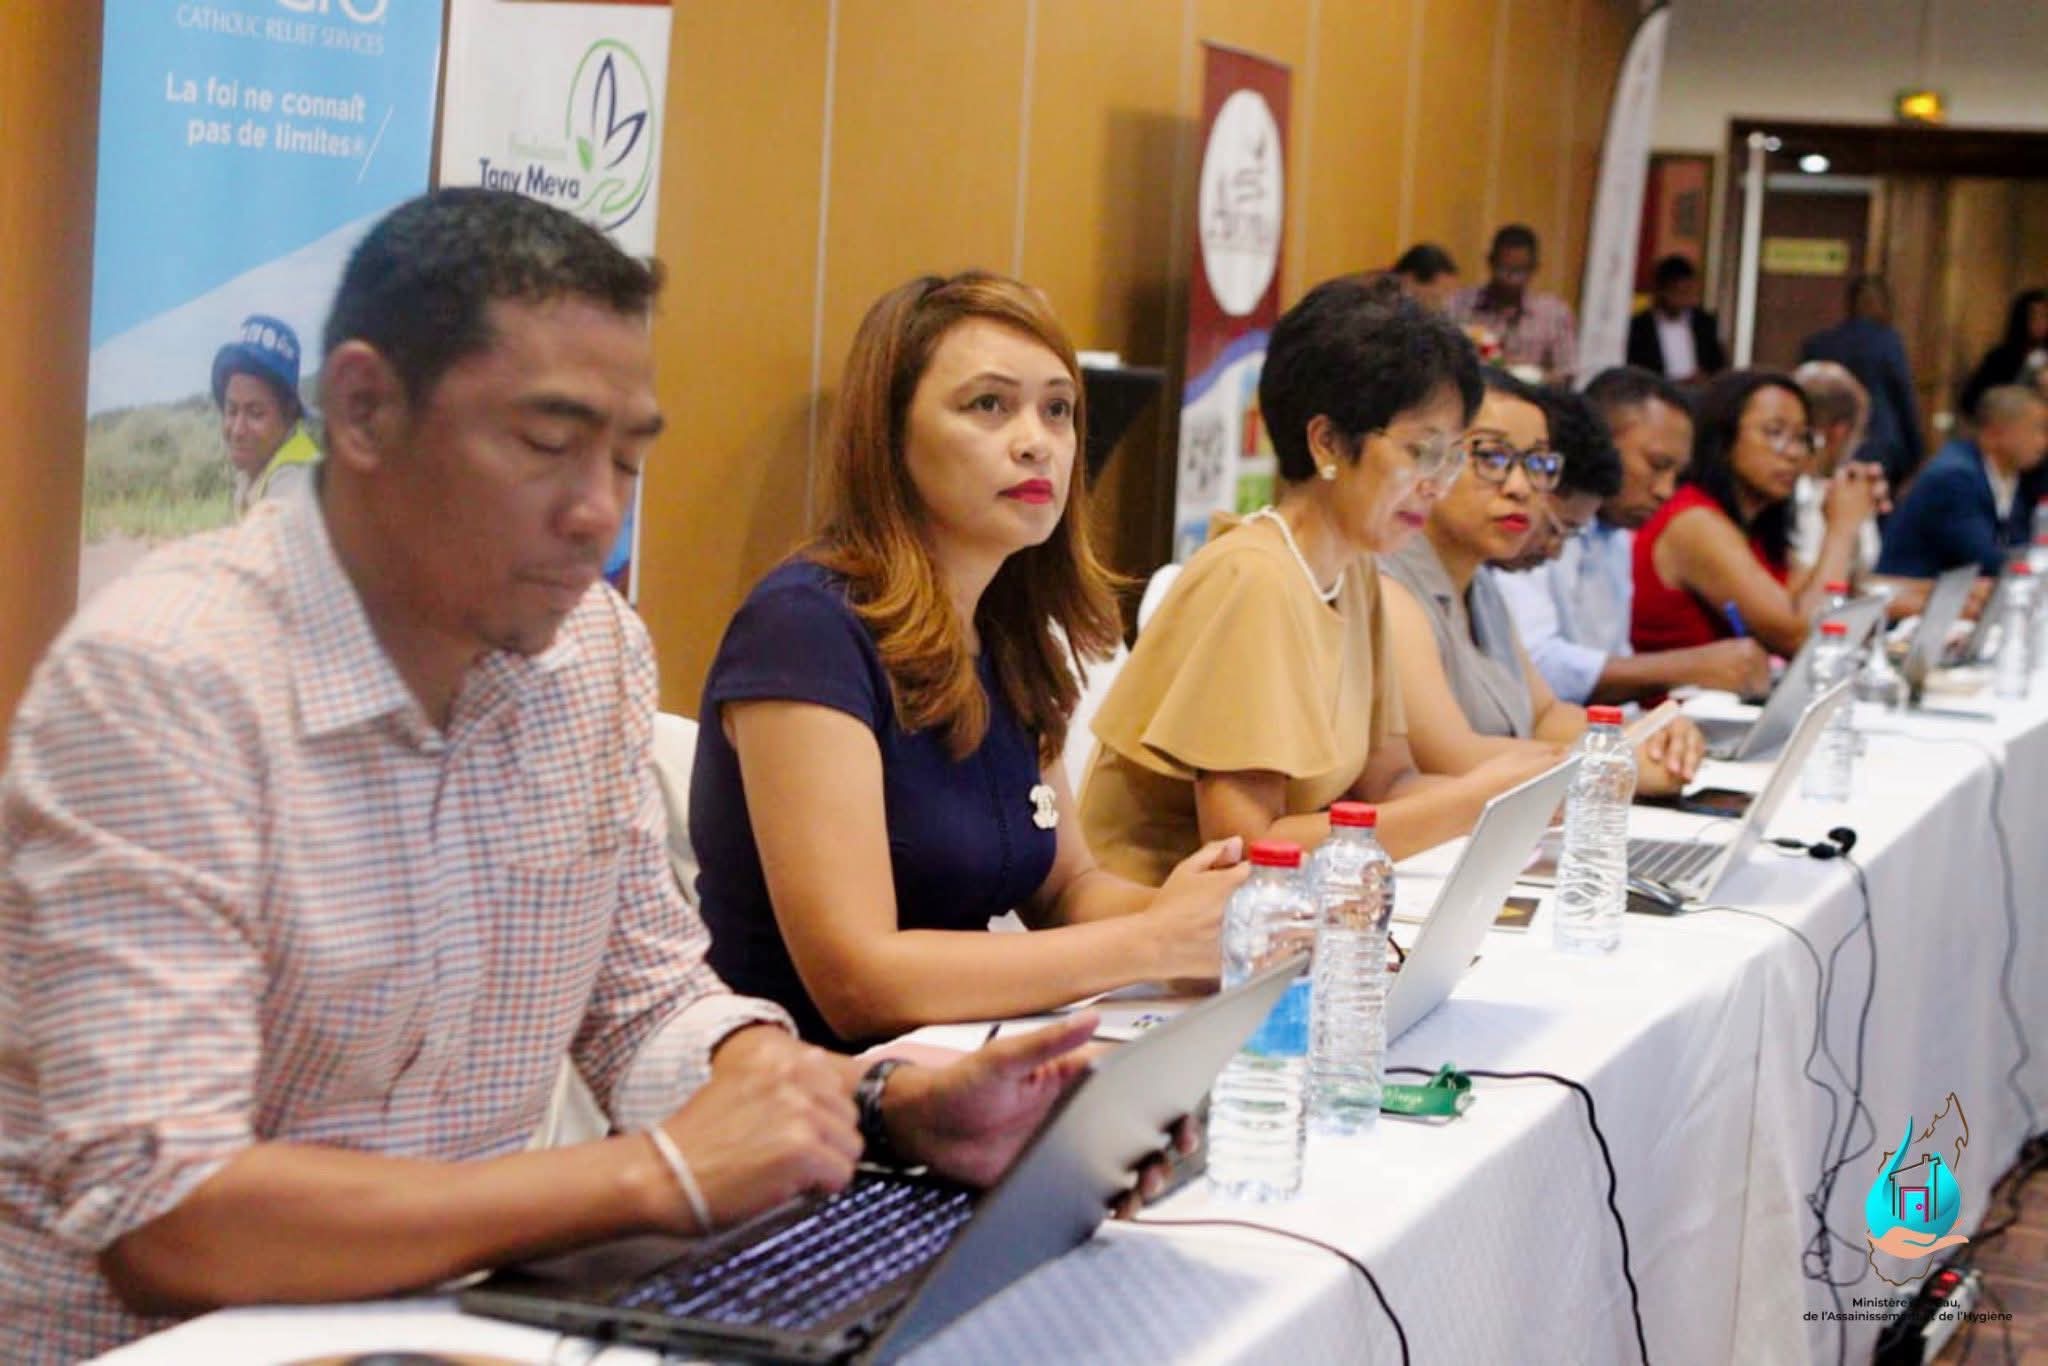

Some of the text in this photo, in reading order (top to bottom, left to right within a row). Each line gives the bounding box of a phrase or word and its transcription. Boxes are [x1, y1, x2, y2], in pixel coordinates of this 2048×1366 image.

[166, 71, 197, 104] La
[207, 76, 239, 108] foi
[245, 88, 274, 113] ne
[188, 118, 233, 146] pas
[238, 118, 267, 148] de
[479, 157, 579, 198] Tany Meva
